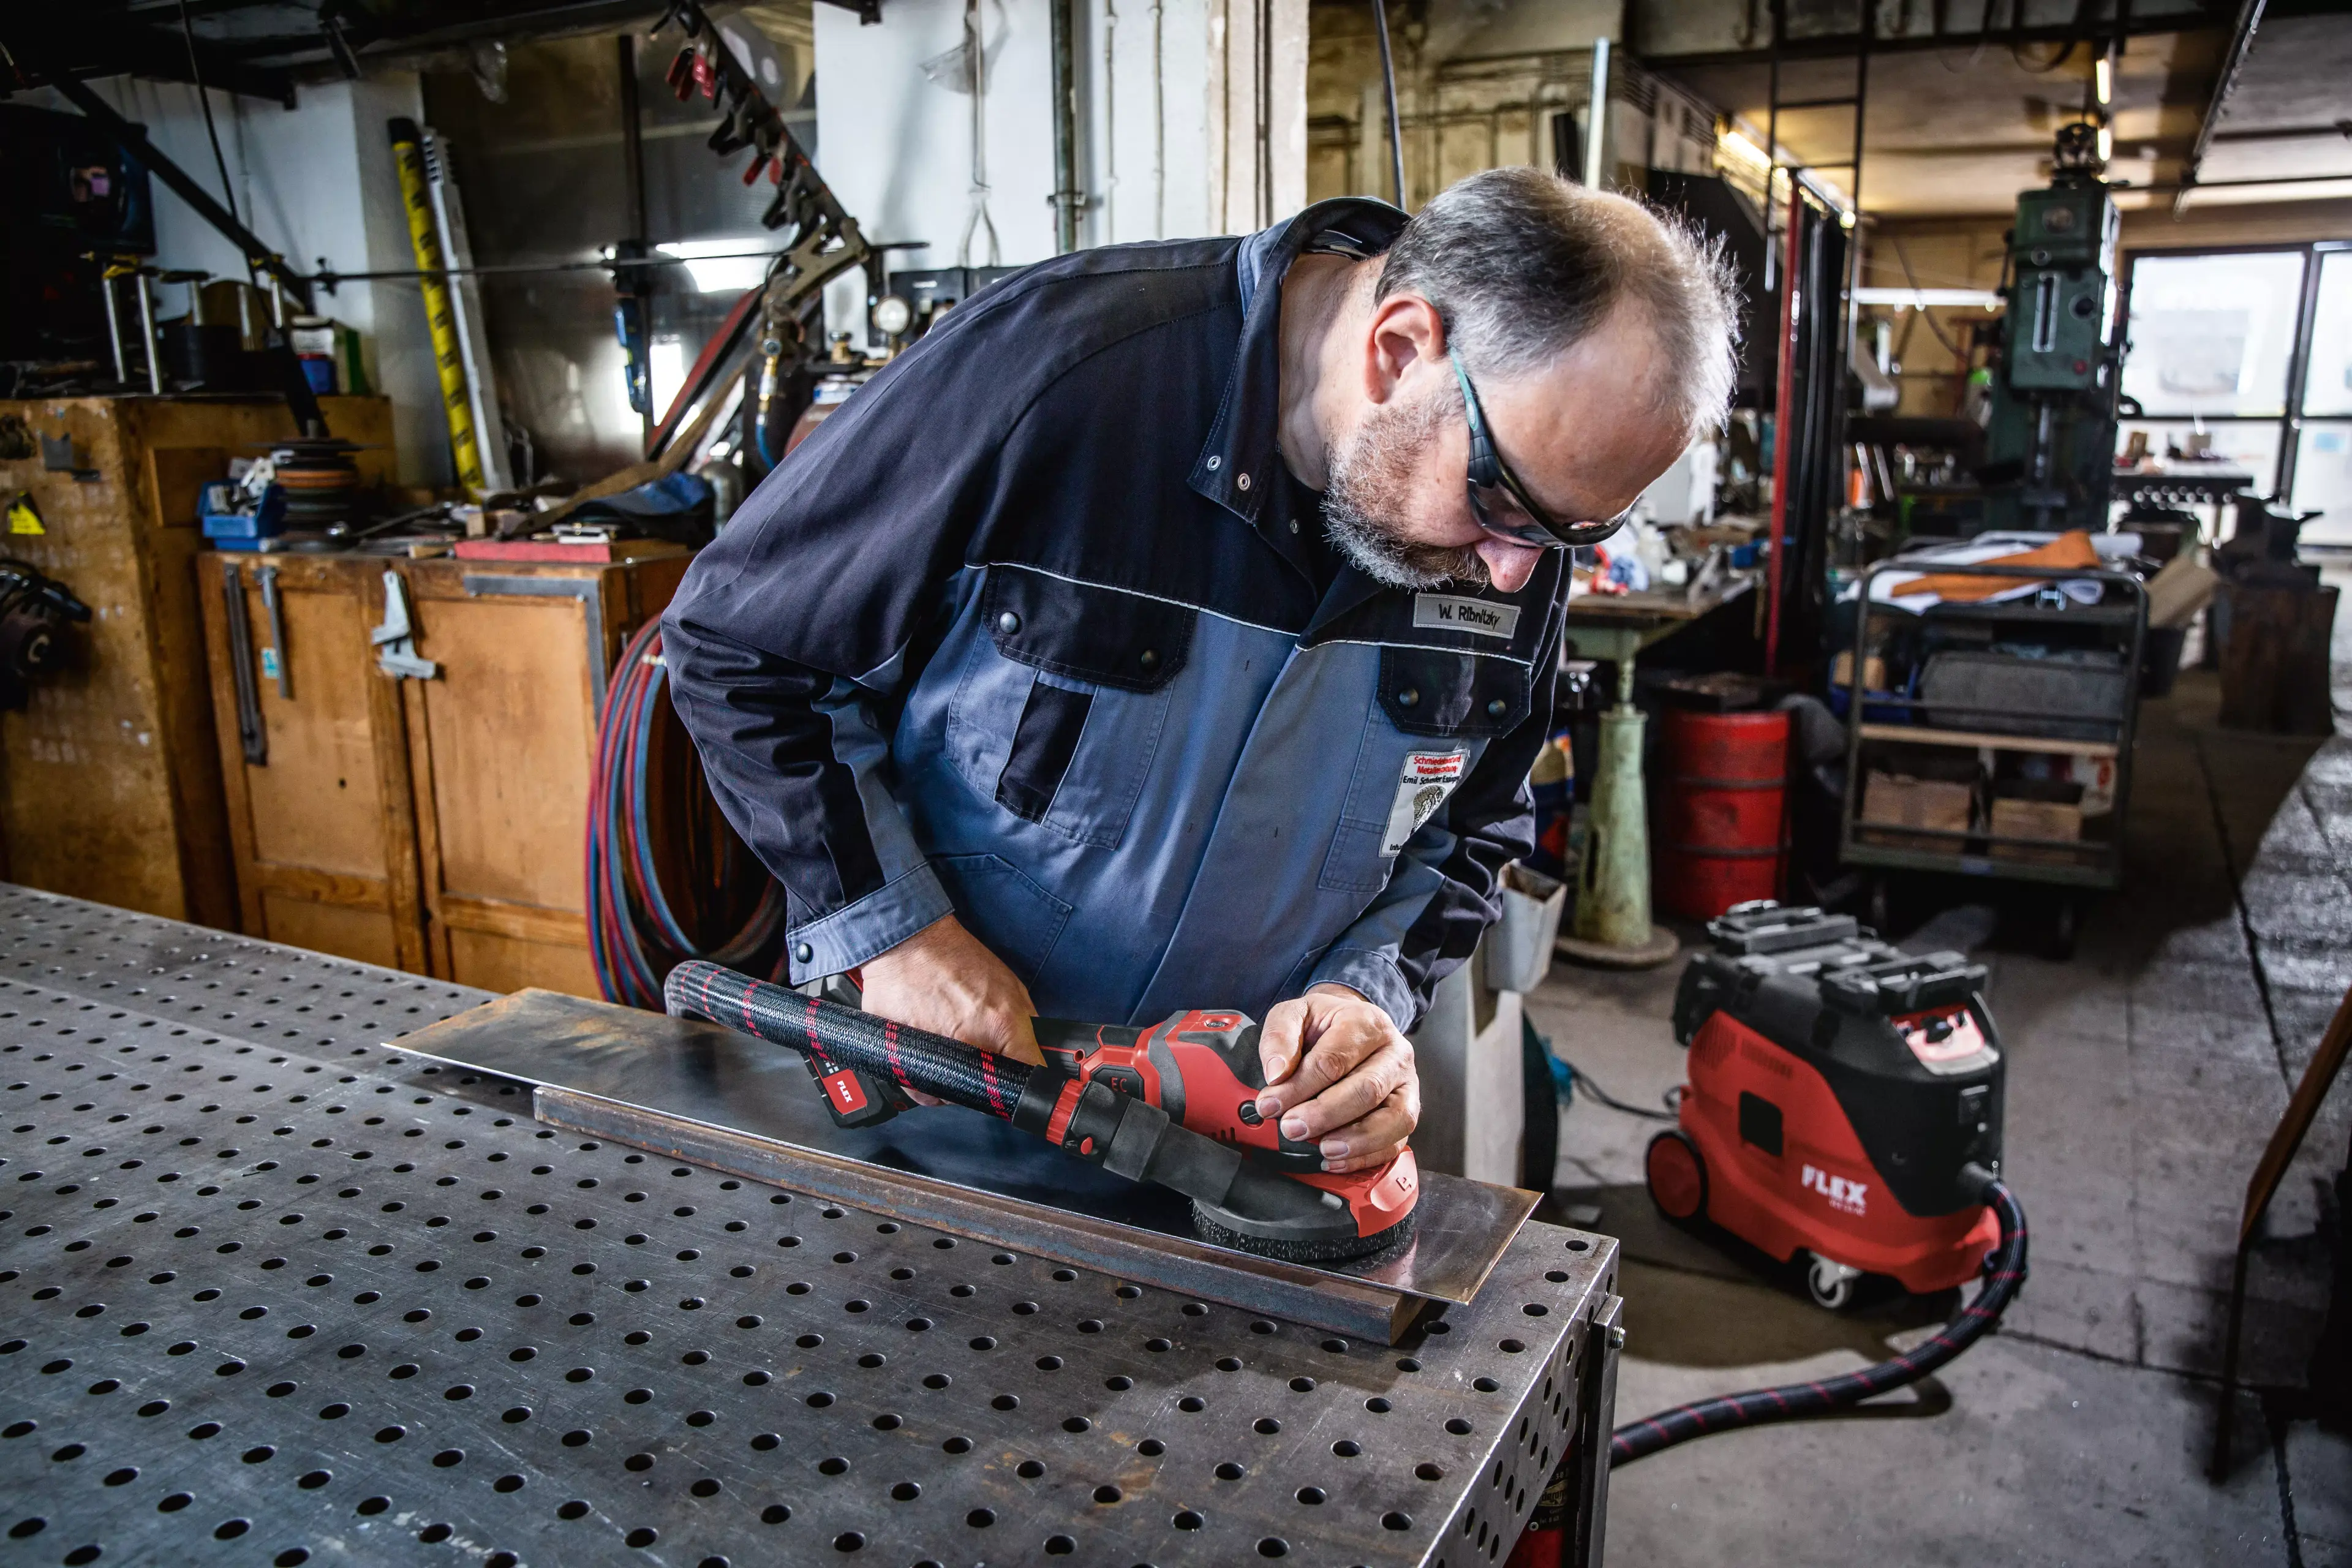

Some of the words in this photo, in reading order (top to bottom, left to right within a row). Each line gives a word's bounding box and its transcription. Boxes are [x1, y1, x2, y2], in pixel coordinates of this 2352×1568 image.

[1439, 603, 1452, 619] W.
[1403, 775, 1418, 785] Emil
[837, 1080, 853, 1103] FLEX
[1111, 1077, 1128, 1093] EC
[1801, 1164, 1868, 1207] FLEX
